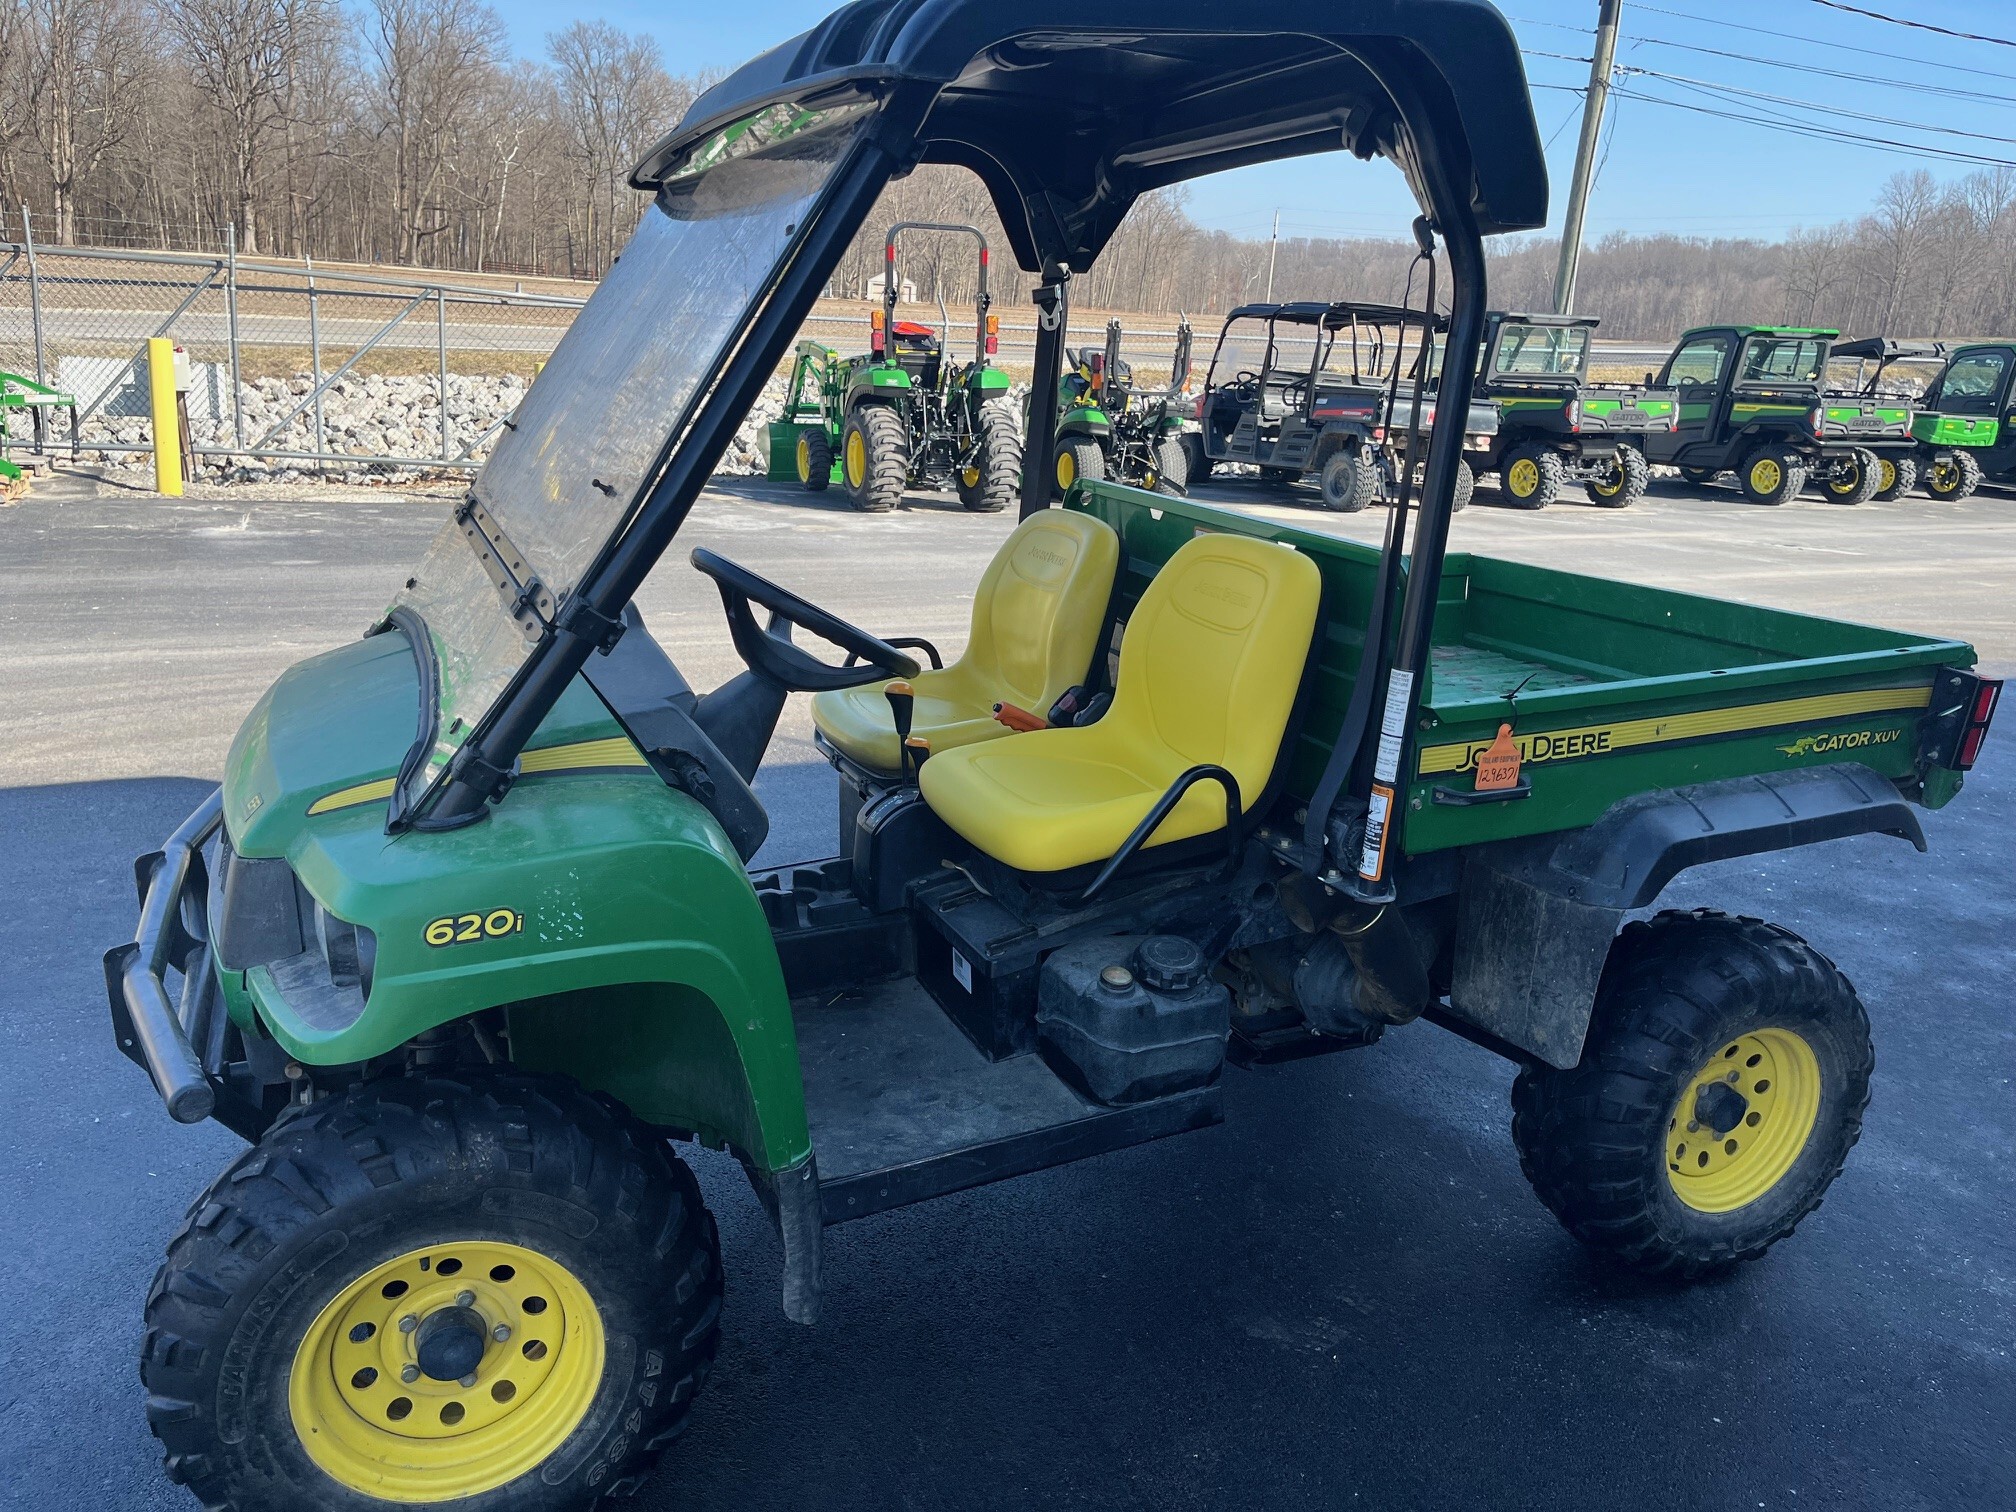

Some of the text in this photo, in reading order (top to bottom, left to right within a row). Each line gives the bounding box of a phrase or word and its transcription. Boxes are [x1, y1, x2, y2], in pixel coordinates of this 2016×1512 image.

[1455, 731, 1612, 770] JON DEERE
[1812, 729, 1901, 752] GATOR XUV
[424, 908, 524, 946] 620i
[222, 1261, 303, 1397] CARLISLE
